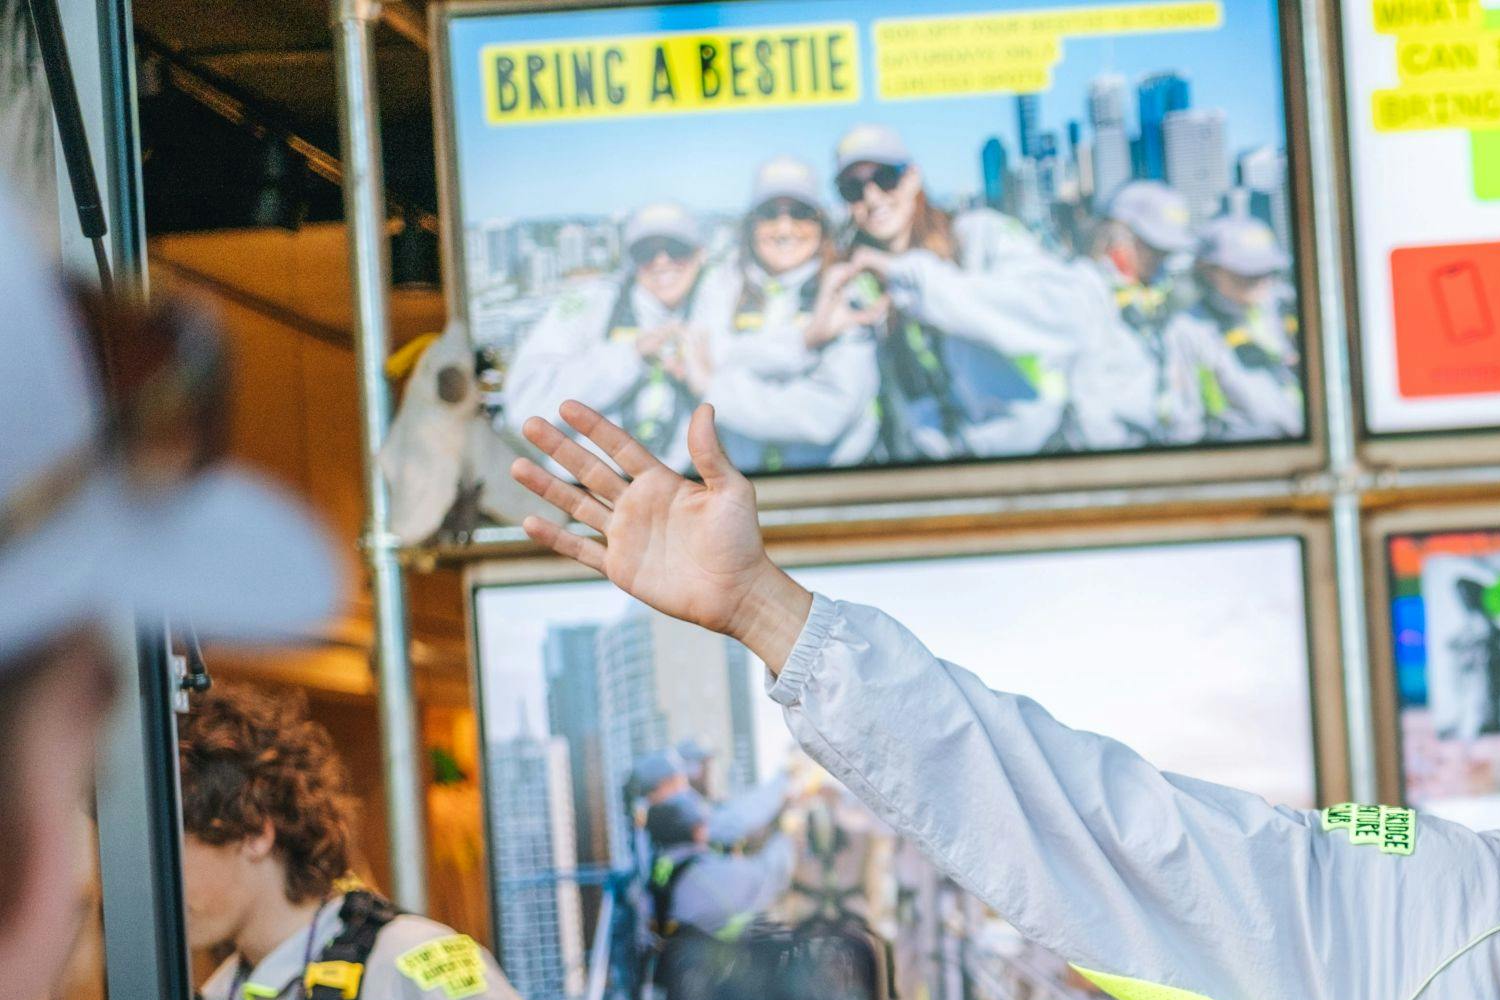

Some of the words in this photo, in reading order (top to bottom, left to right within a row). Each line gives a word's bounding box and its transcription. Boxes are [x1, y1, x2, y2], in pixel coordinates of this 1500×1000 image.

[495, 48, 625, 113] BRING
[649, 45, 677, 103] A
[698, 33, 846, 99] BESTIE
[1401, 41, 1480, 75] CAN
[1384, 812, 1410, 850] BRIDGE
